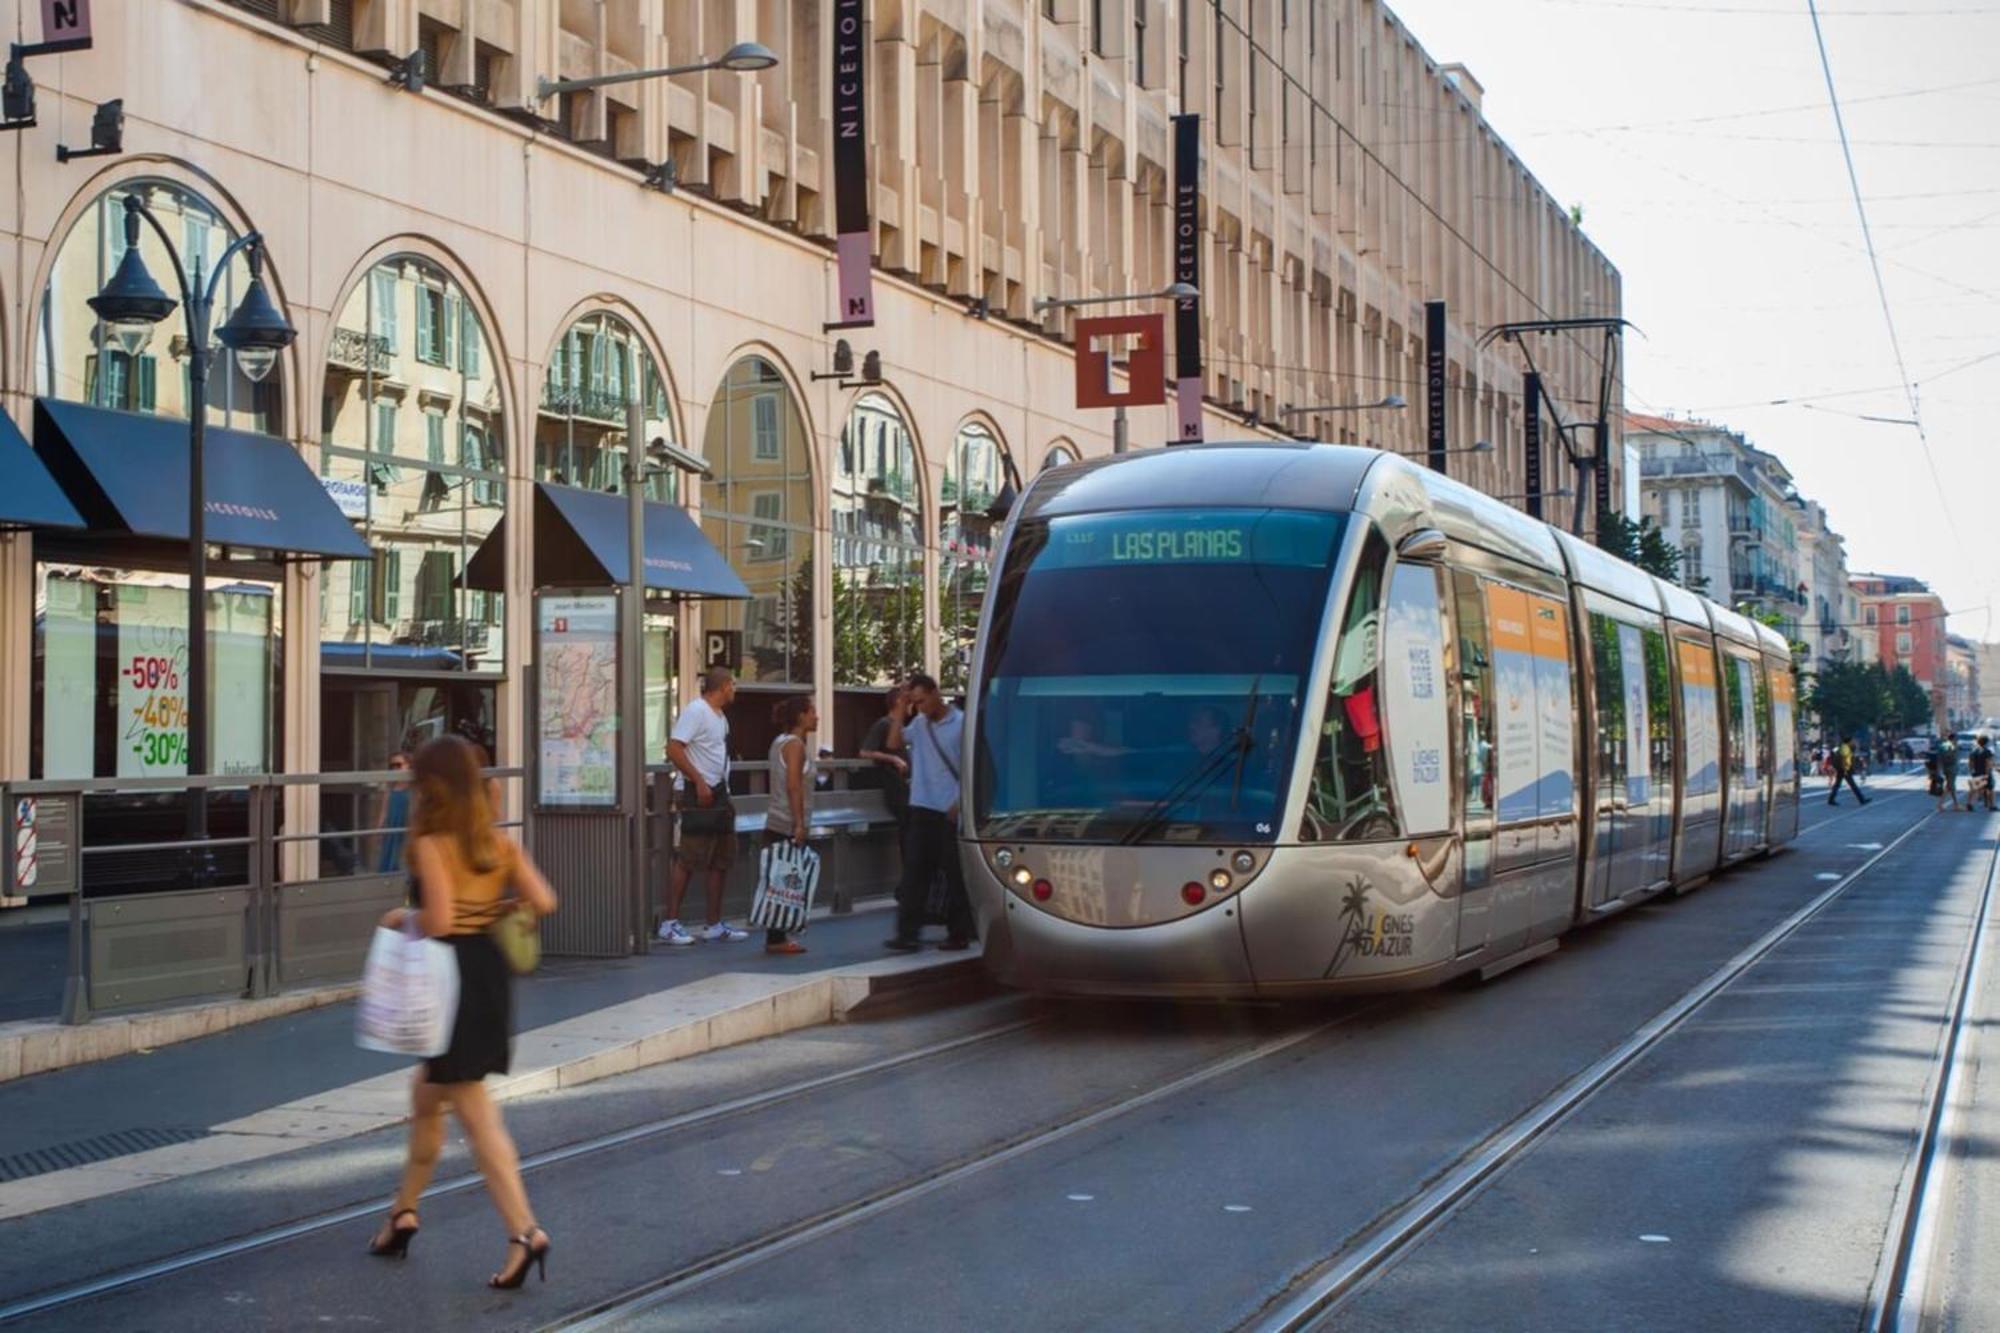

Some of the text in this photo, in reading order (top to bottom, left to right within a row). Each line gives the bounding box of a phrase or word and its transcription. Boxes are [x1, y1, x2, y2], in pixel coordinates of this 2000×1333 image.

[53, 0, 78, 30] N
[1179, 185, 1193, 310] NCETOILE
[849, 298, 865, 315] N
[1089, 332, 1152, 395] T
[1431, 351, 1441, 439] NICETOILE
[1113, 530, 1242, 560] LAS PLANAS
[708, 635, 725, 665] P
[122, 656, 178, 690] -50%
[133, 696, 188, 728] -40%
[133, 733, 189, 766] -30%
[1256, 822, 1271, 834] 06
